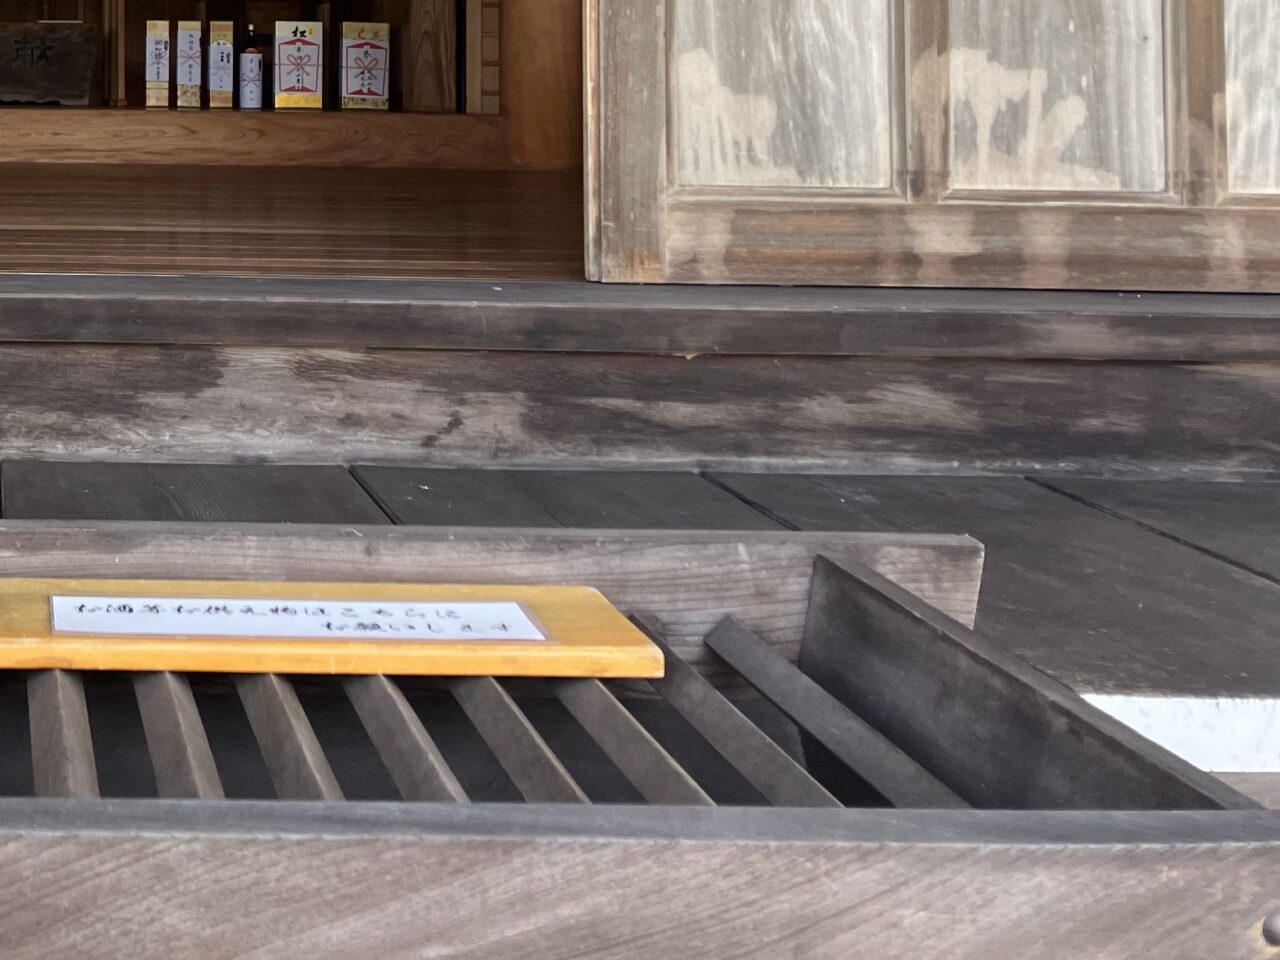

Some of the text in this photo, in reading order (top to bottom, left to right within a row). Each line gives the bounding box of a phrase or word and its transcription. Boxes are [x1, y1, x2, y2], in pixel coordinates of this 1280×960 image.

[291, 25, 308, 38] 松
[321, 621, 510, 634] お願いします
